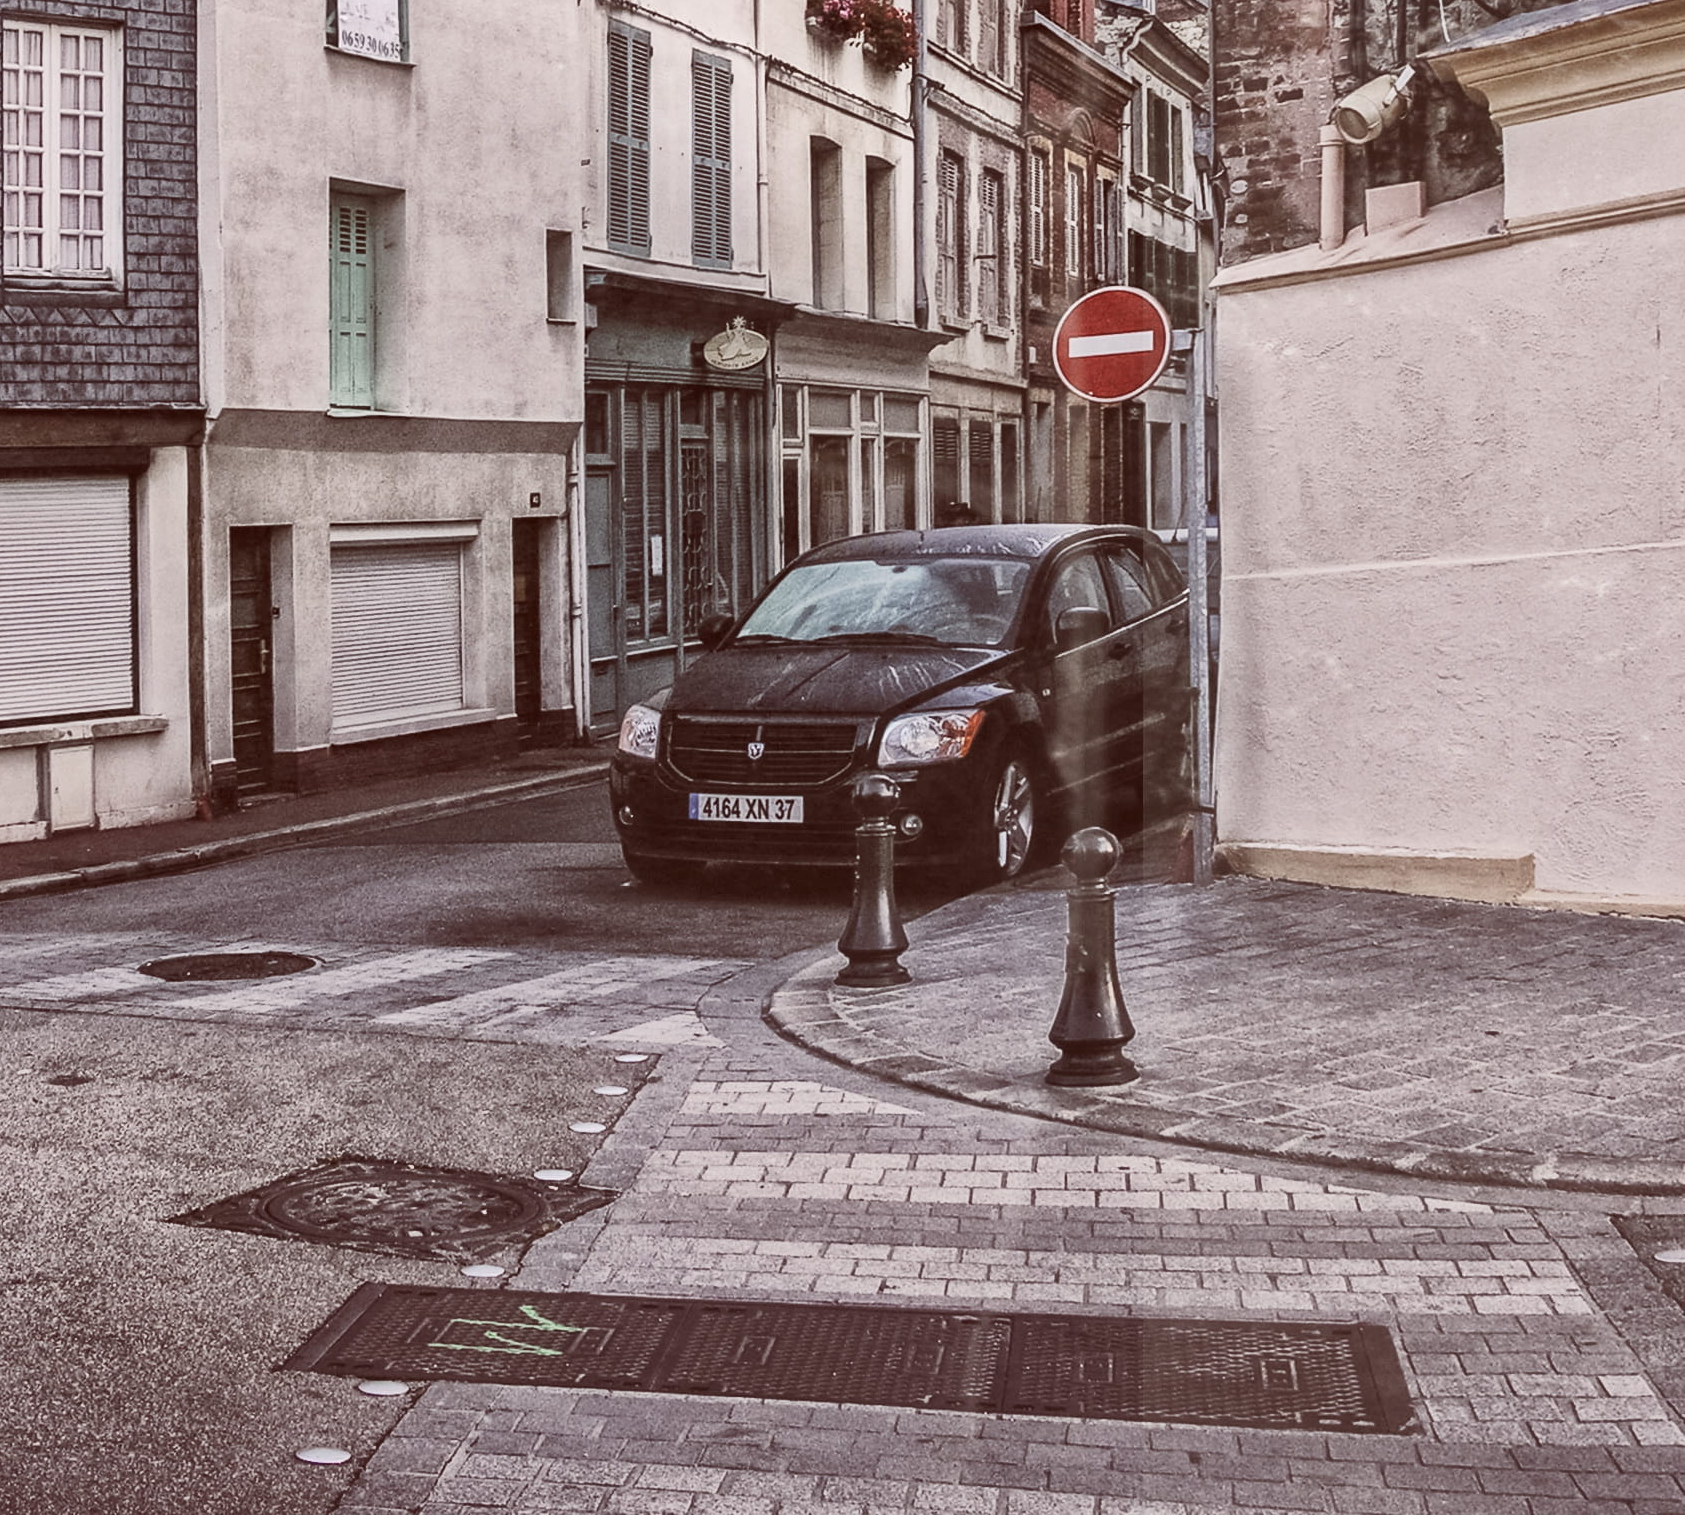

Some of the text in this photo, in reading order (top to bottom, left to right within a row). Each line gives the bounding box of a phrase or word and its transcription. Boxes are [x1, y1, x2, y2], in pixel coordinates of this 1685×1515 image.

[702, 796, 795, 821] 4164 XN 37
